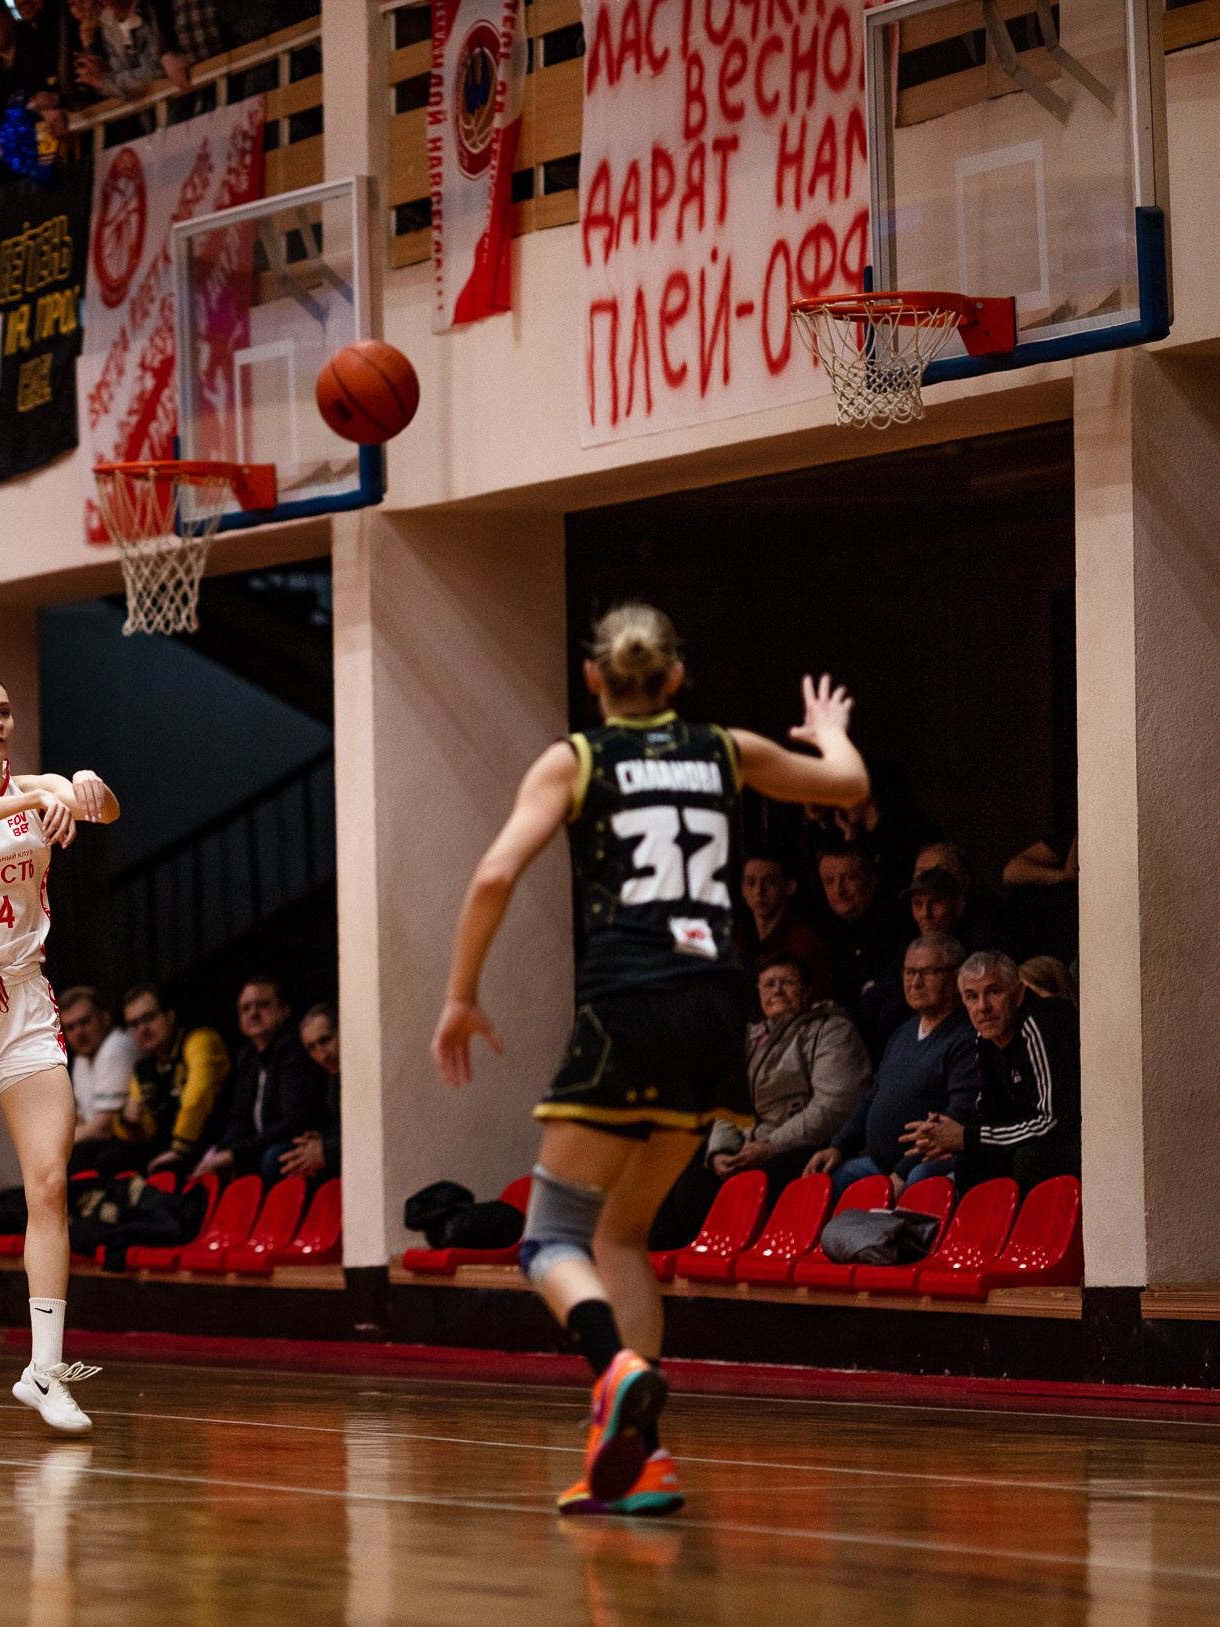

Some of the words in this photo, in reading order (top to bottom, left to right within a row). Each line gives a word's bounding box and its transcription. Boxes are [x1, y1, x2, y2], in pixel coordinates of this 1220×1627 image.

[684, 6, 866, 141] ВеСНО
[582, 136, 740, 267] ДАРЯТ
[610, 804, 732, 909] 32
